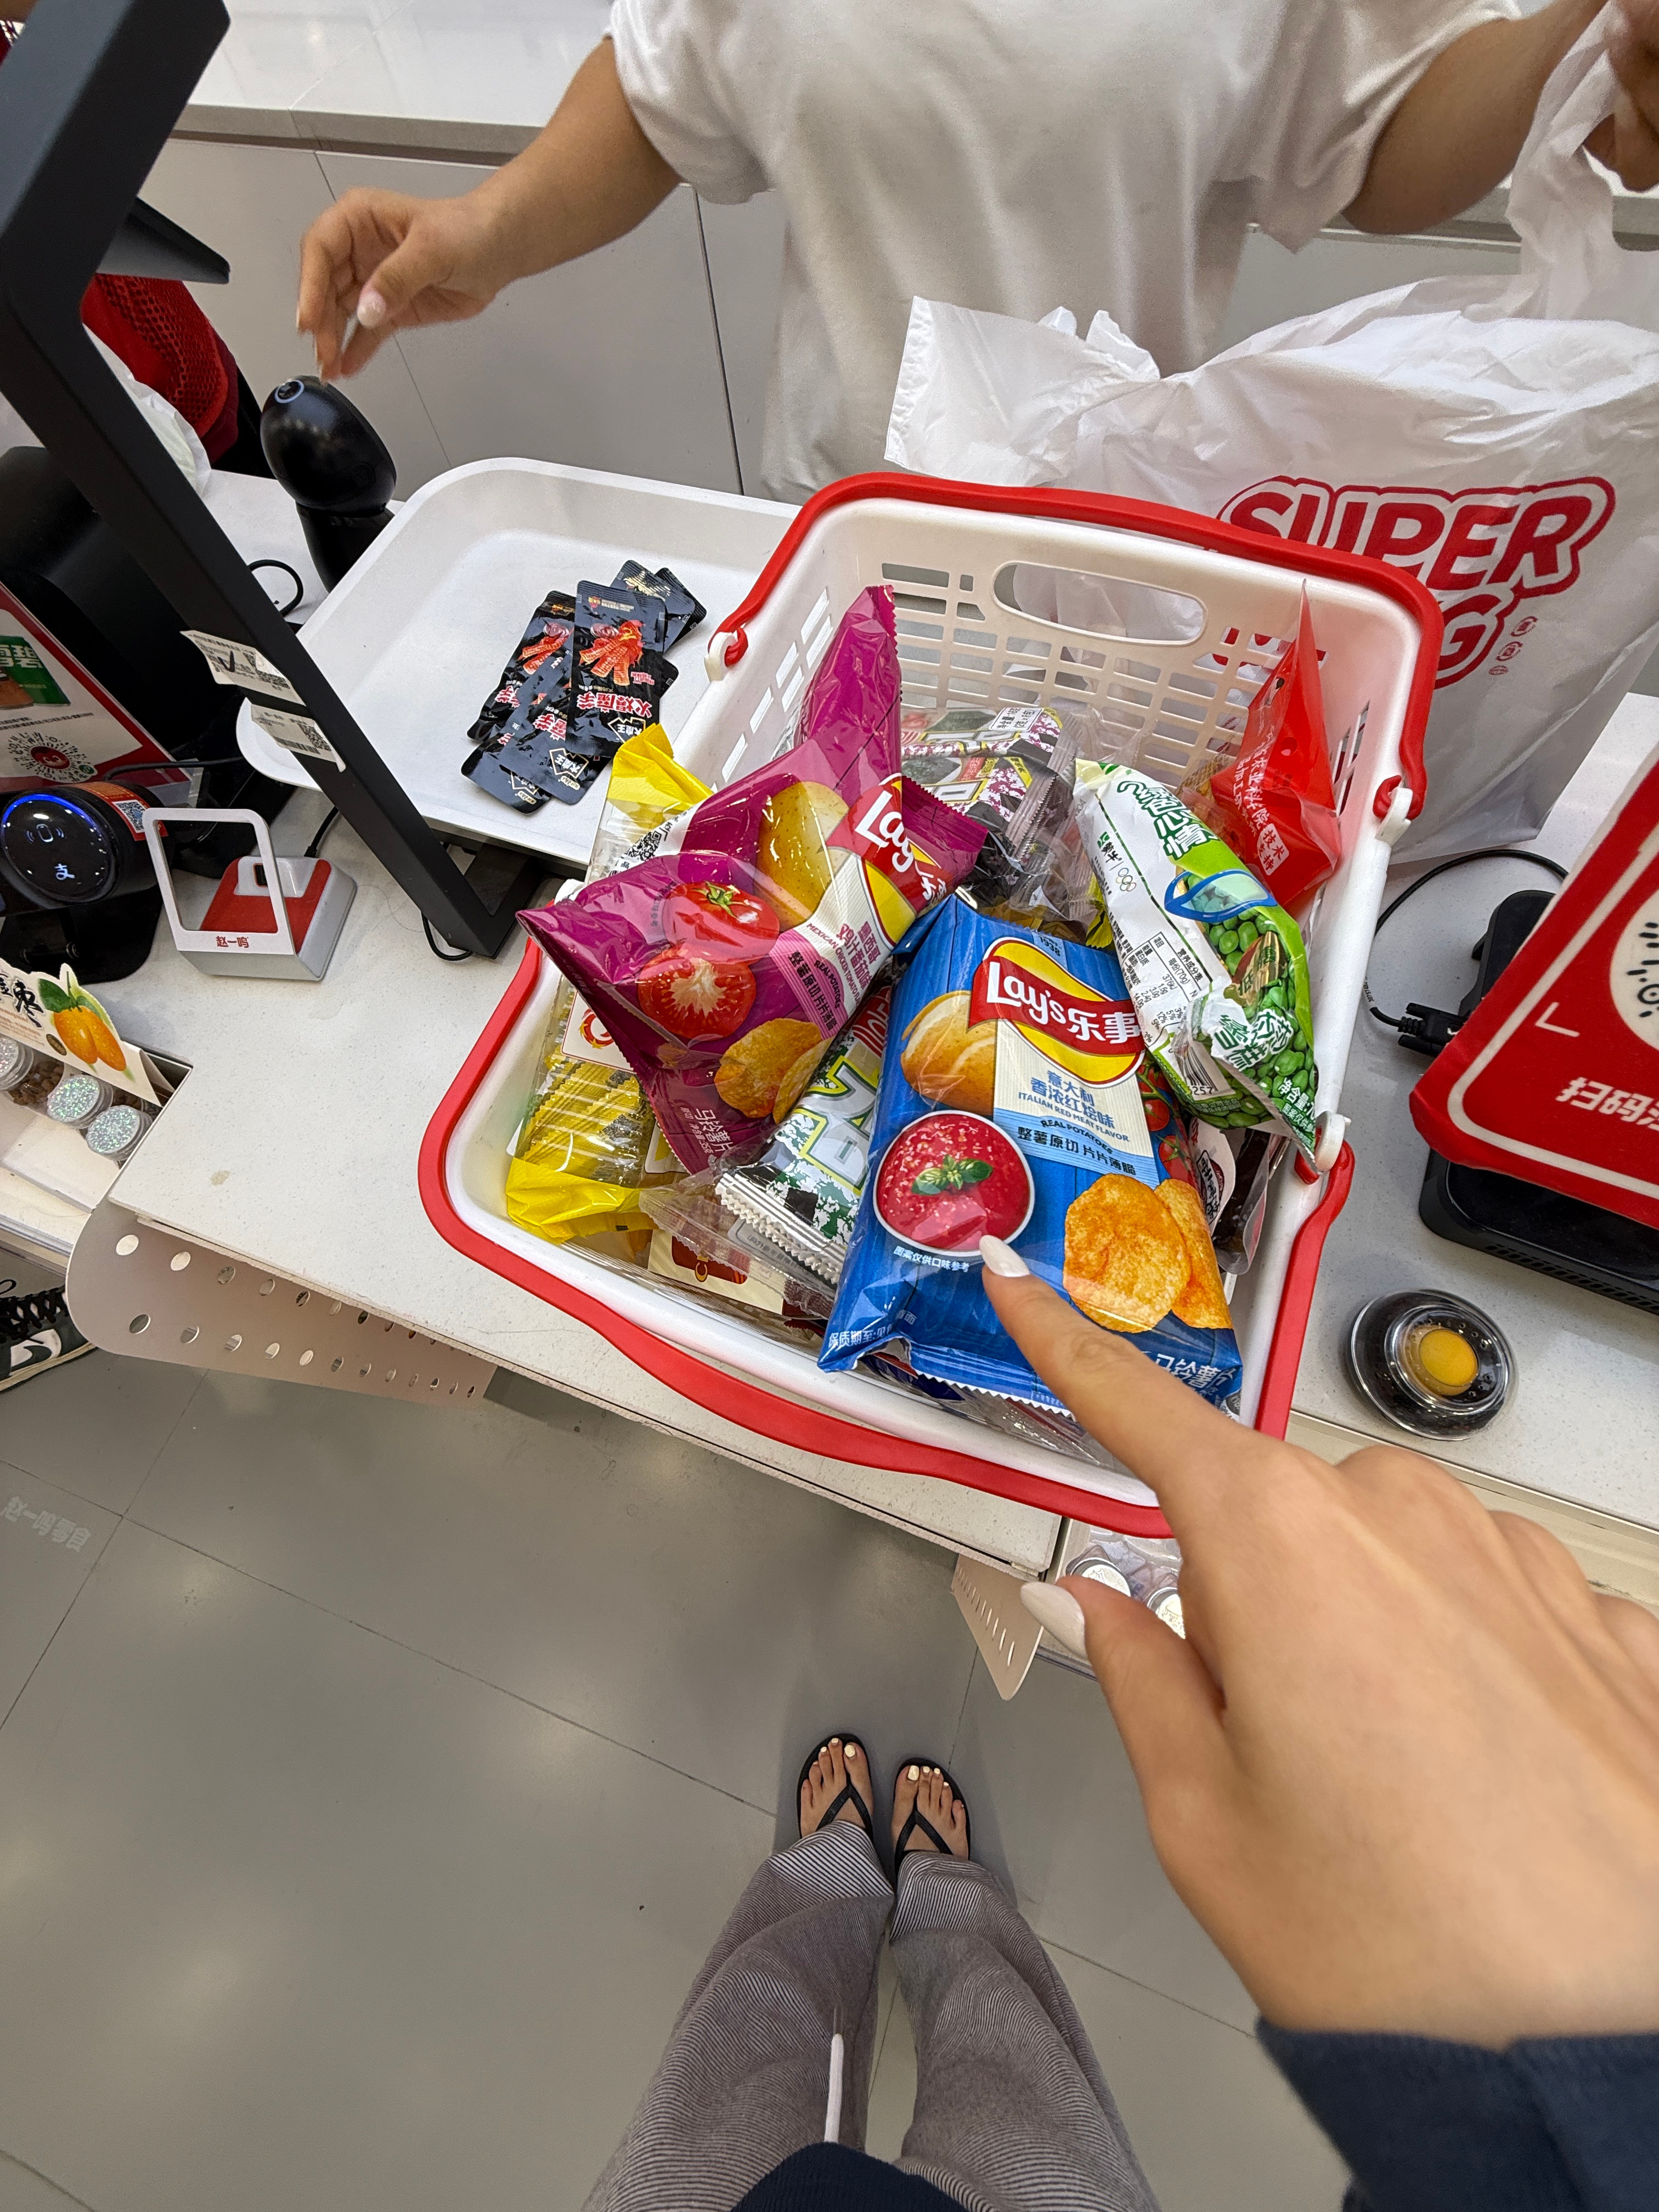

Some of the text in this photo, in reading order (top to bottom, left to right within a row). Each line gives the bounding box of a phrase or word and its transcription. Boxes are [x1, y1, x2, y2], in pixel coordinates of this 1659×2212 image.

[577, 691, 653, 719] 火爆魔芋
[1117, 780, 1220, 860] 绿色心情
[1101, 842, 1122, 864] 蒙牛
[216, 935, 250, 949] 赵一鸣
[806, 922, 839, 949] MEXICAN
[834, 947, 851, 973] CHICKEN
[844, 969, 859, 994] TOMATO
[836, 923, 873, 990] 鸡汁番茄味
[857, 921, 881, 965] 墨西哥
[1037, 936, 1061, 957] 1938
[1135, 950, 1150, 967] 蛋白质
[814, 960, 842, 1009] REAL POTATOES
[1176, 947, 1204, 983] 营养成分表
[788, 950, 838, 1031] 整薯原切 片片薄脆
[986, 961, 1142, 1045] Lay's 乐事
[1030, 1077, 1115, 1128] 香浓红烩味
[1046, 1070, 1096, 1108] 意大利
[694, 1107, 734, 1154] 马铃薯片
[1017, 1092, 1130, 1143] ITALIAN RED MEAT FLAVOR
[1041, 1119, 1114, 1154] REAL POTATOES
[1017, 1126, 1137, 1176] 整薯原切 片片薄脆
[892, 1245, 970, 1273] 图案仅供口味参考
